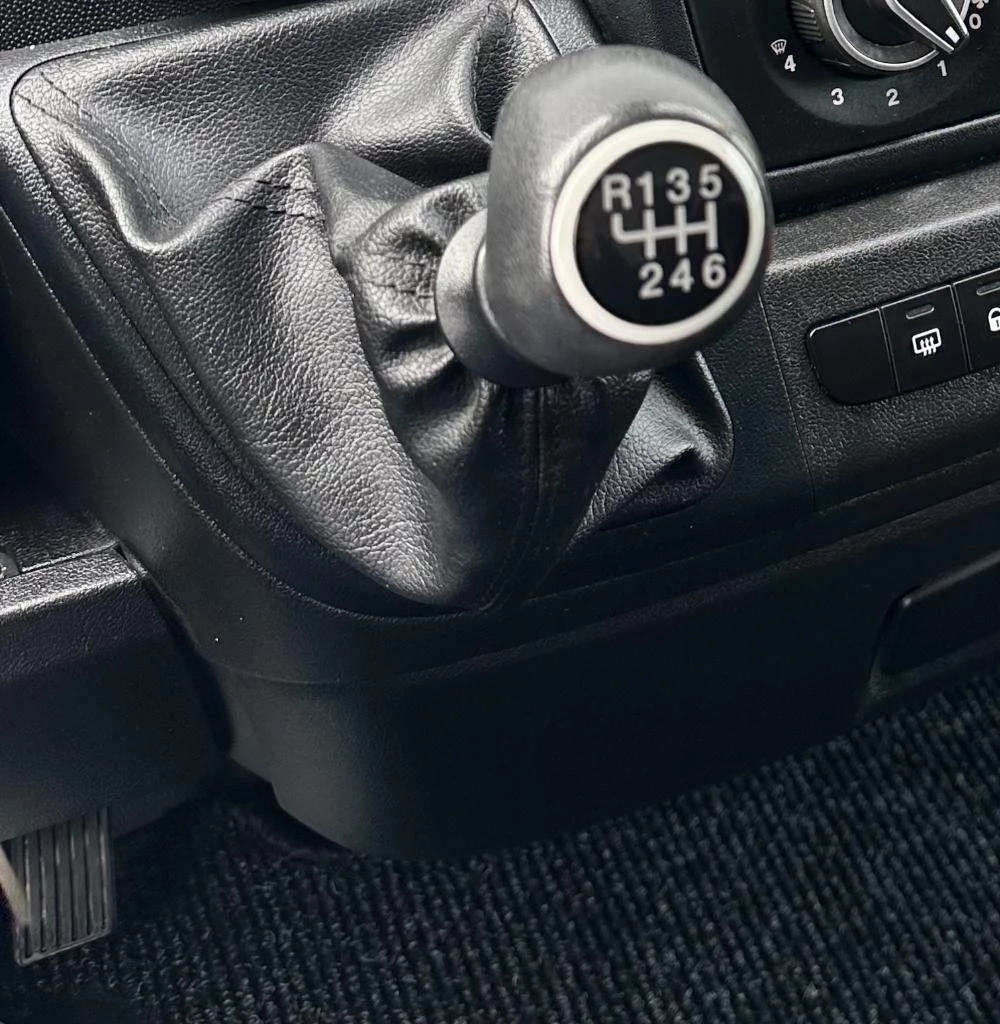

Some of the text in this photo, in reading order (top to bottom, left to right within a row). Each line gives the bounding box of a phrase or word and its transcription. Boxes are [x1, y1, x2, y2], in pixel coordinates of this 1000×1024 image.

[784, 54, 797, 73] 4
[936, 59, 948, 77] 1
[830, 87, 845, 106] 3
[886, 88, 900, 107] 2
